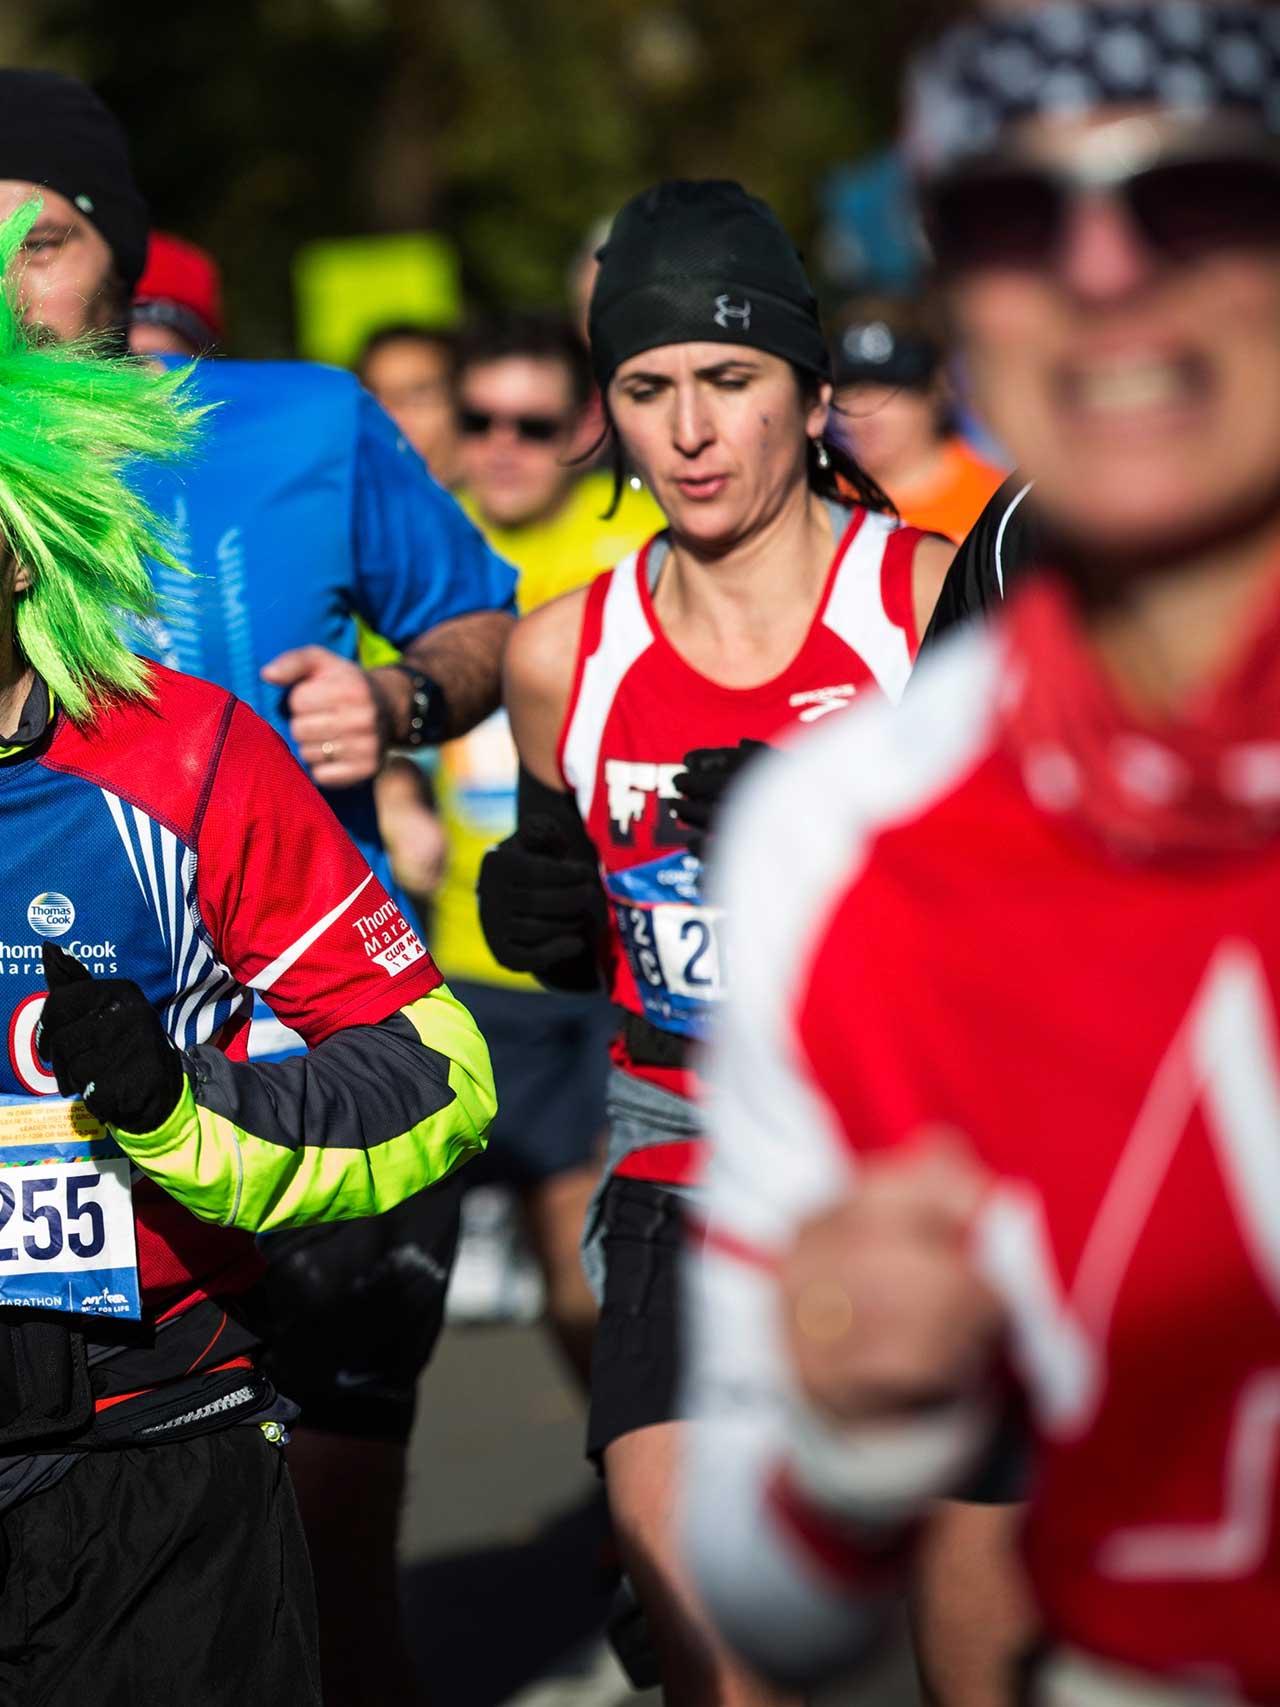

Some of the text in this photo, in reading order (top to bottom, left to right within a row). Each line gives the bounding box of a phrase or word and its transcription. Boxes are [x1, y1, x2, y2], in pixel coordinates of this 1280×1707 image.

[31, 906, 72, 916] Thomas
[46, 915, 71, 925] Cook
[69, 940, 117, 959] Cook
[384, 941, 406, 962] CLUB
[680, 919, 713, 986] 2
